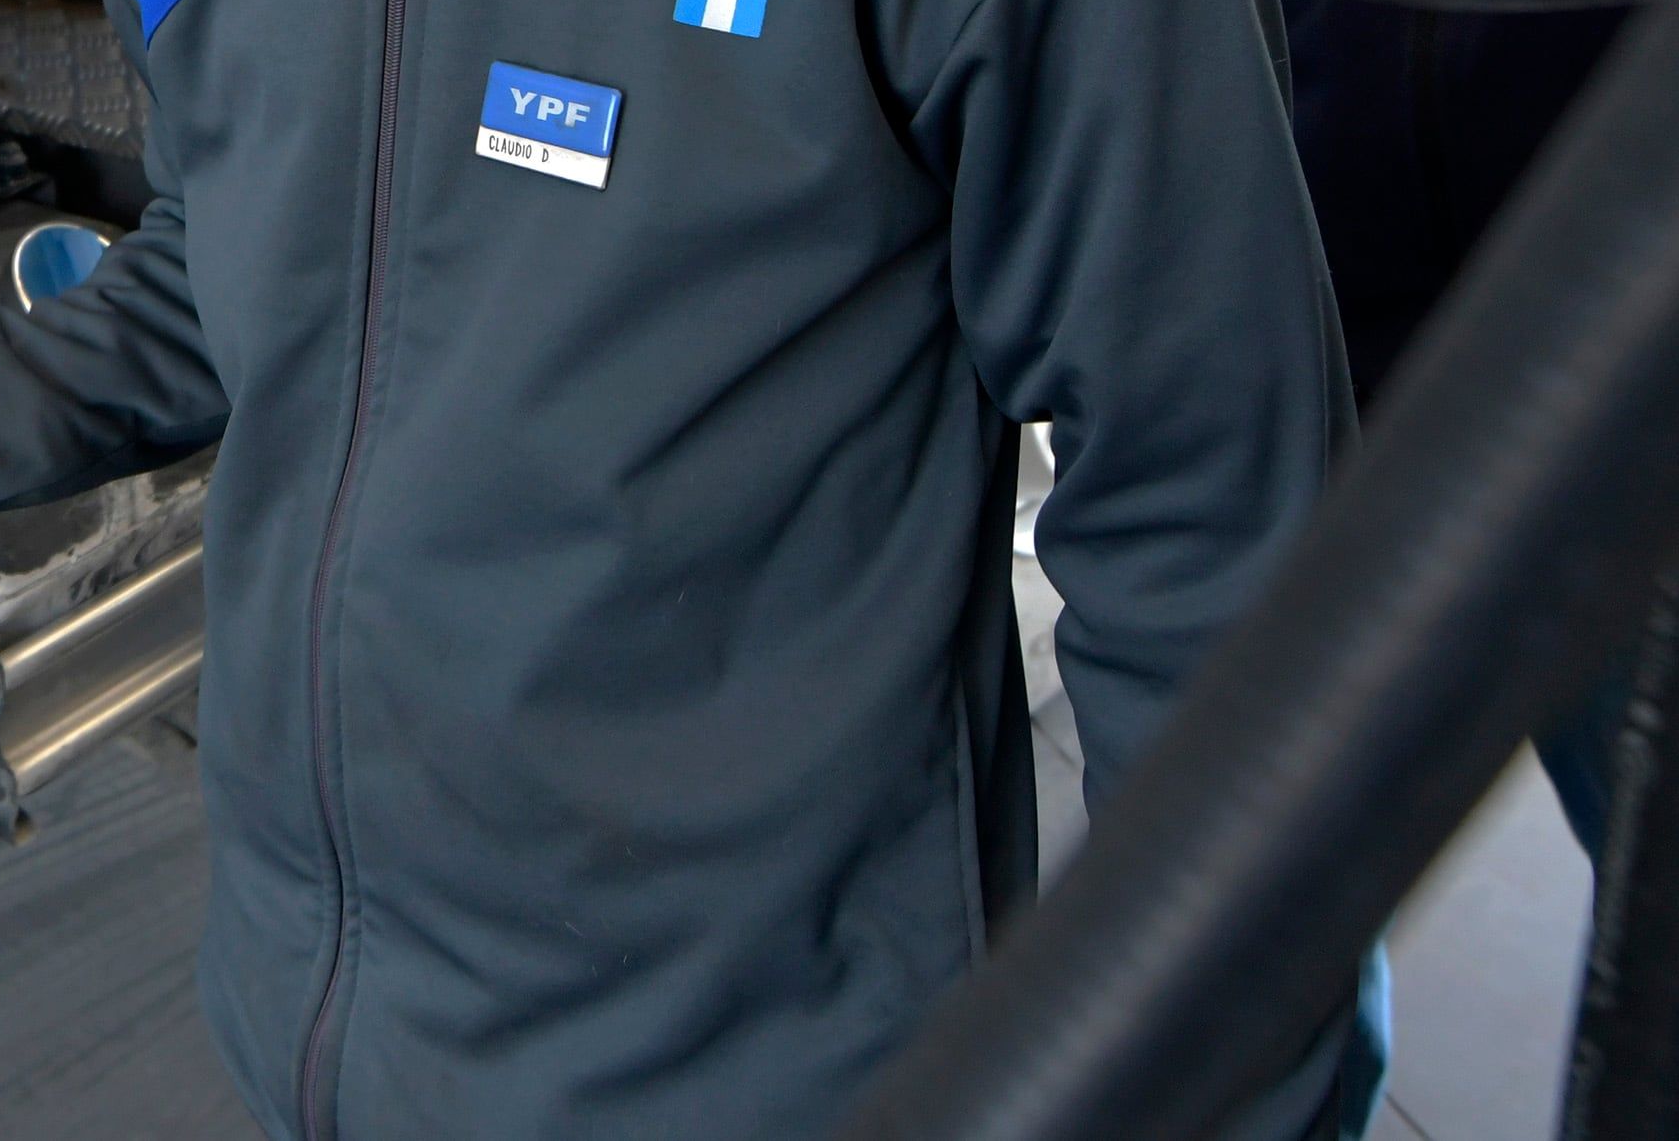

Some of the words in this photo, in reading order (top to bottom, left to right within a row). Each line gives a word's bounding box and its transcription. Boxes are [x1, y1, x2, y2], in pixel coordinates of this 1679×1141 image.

[510, 88, 591, 127] YPF
[488, 135, 532, 160] CLAUDIO
[541, 148, 549, 163] D
